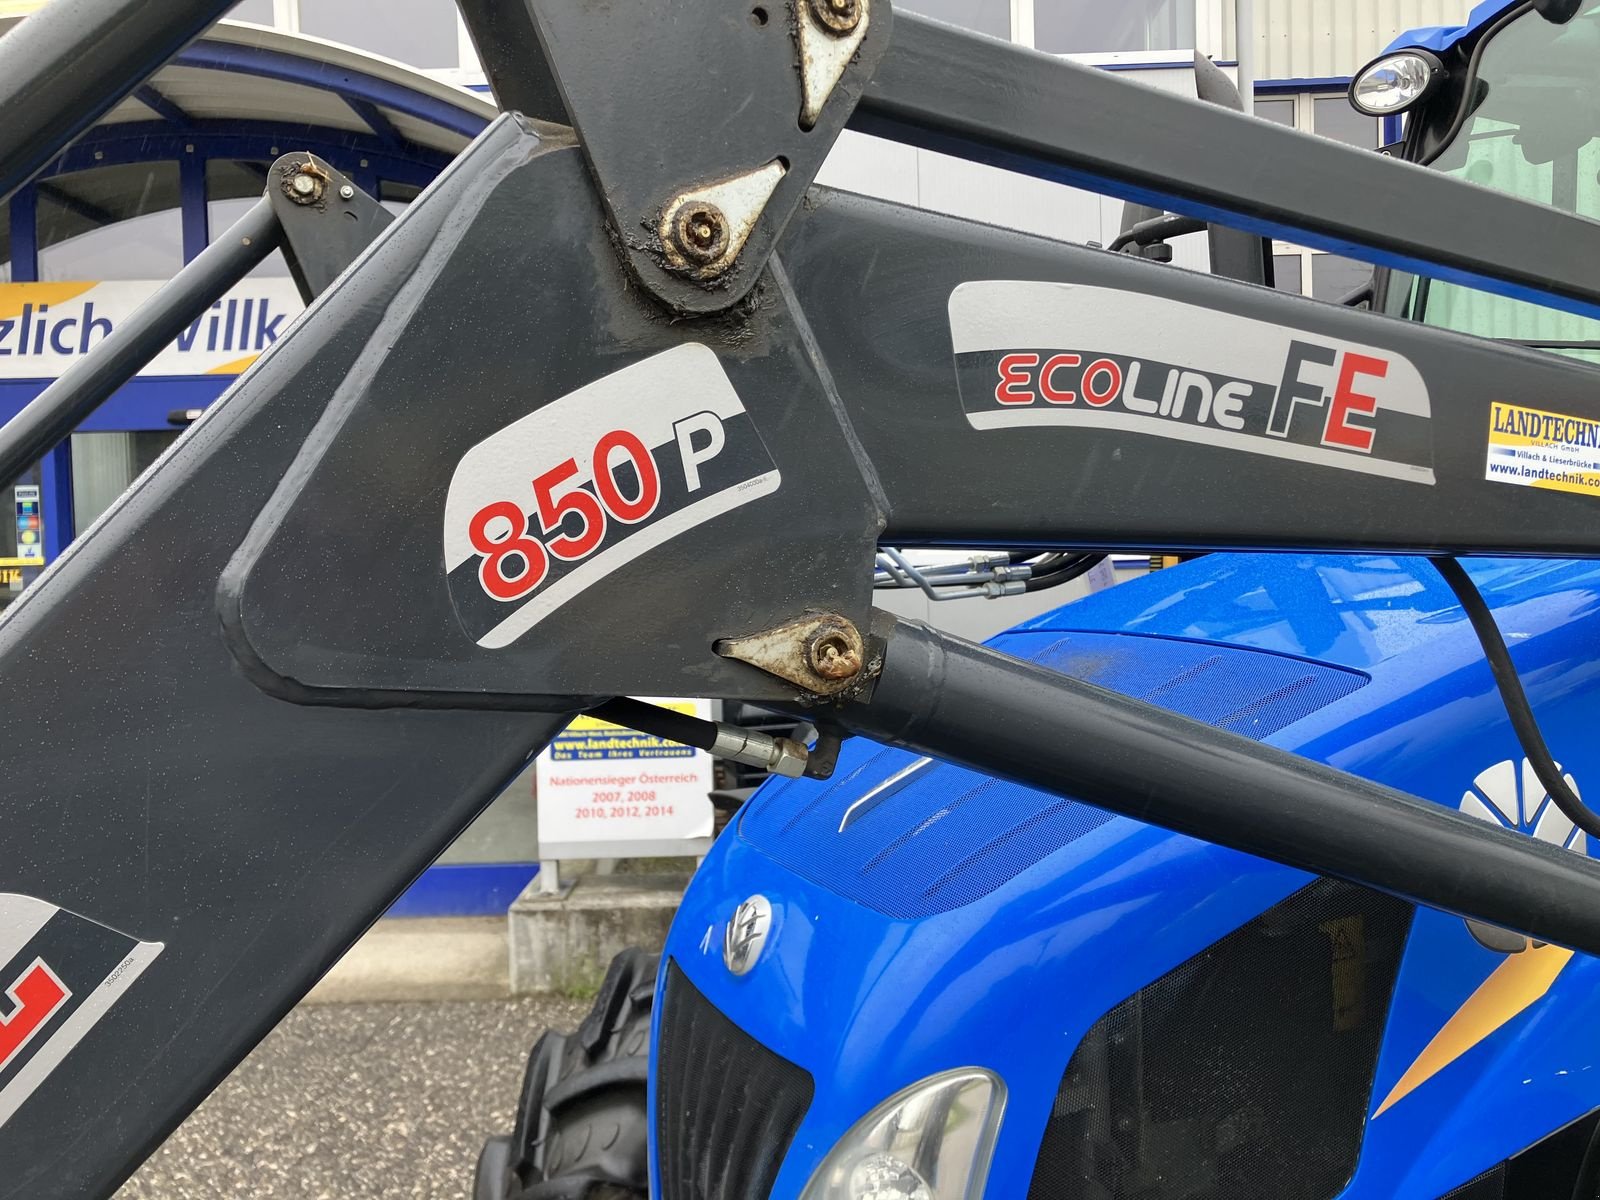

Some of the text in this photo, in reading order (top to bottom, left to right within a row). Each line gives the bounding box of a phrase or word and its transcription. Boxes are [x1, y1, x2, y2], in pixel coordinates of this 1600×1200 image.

[995, 339, 1389, 454] ECOLINE FE
[1493, 407, 1600, 448] LANDTECHN
[1517, 450, 1592, 469] Villach & Lieserbrücke
[468, 411, 725, 602] 850 P
[553, 737, 686, 750] www.landtechnik.co
[553, 748, 693, 760] Das Team Ihres Vertrauens
[550, 772, 698, 787] Nationensieger Österreich
[592, 791, 657, 803] 2007, 2008
[575, 805, 674, 819] 2010, 2012, 2014
